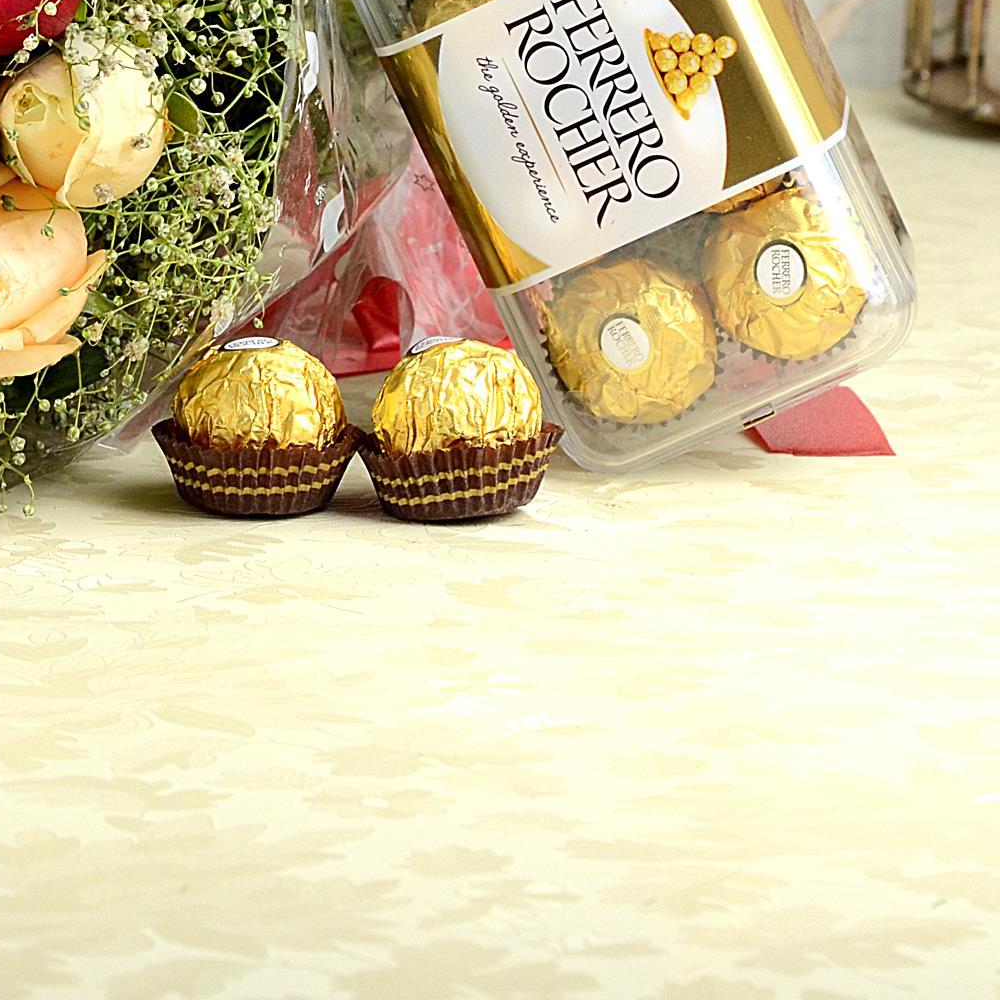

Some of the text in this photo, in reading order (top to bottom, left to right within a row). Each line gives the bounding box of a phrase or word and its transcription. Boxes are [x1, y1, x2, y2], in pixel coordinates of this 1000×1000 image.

[476, 56, 560, 223] the golden experience
[504, 3, 634, 230] ROCHER
[771, 249, 781, 296] ROCHER
[781, 249, 791, 295] FERRERO
